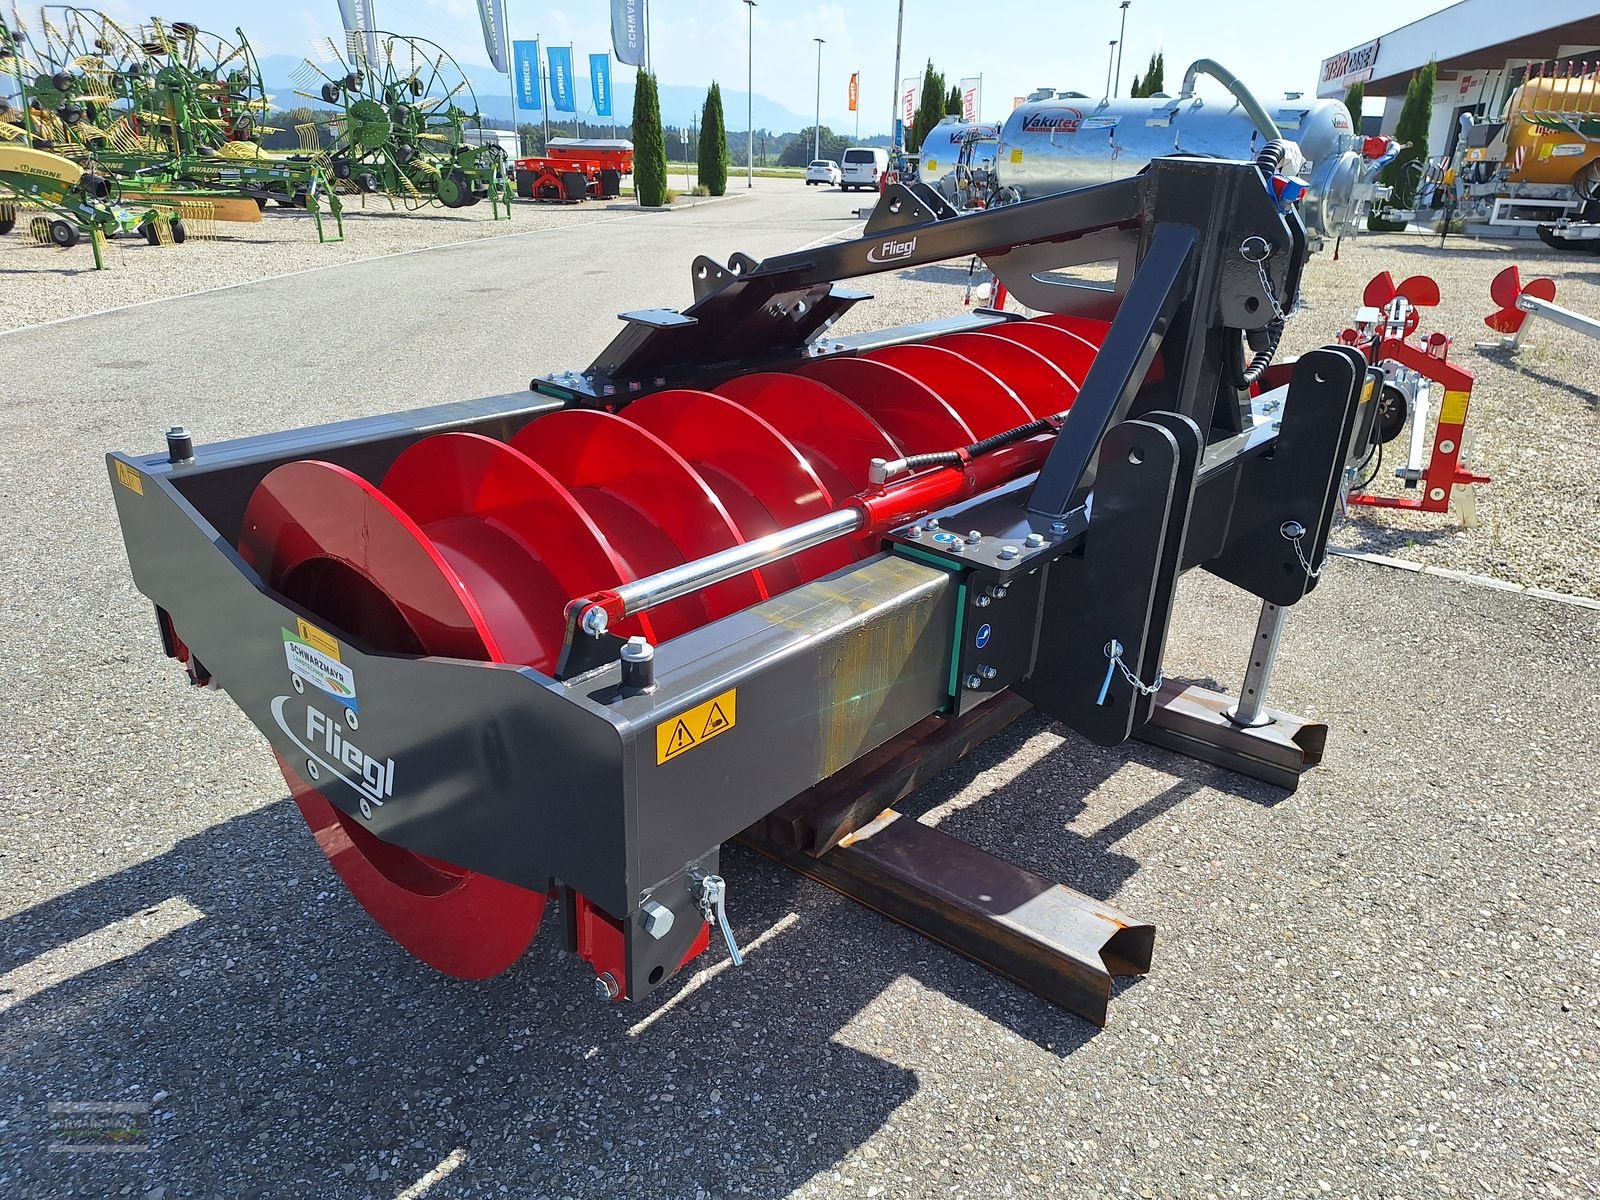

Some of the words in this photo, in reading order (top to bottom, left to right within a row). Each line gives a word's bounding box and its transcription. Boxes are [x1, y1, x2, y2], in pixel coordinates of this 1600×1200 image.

[1022, 113, 1081, 132] Vakutec
[30, 167, 62, 179] KRONE
[881, 236, 917, 257] Fliegl
[289, 642, 345, 683] SCHWARZMAYR
[306, 705, 395, 799] Fliegl
